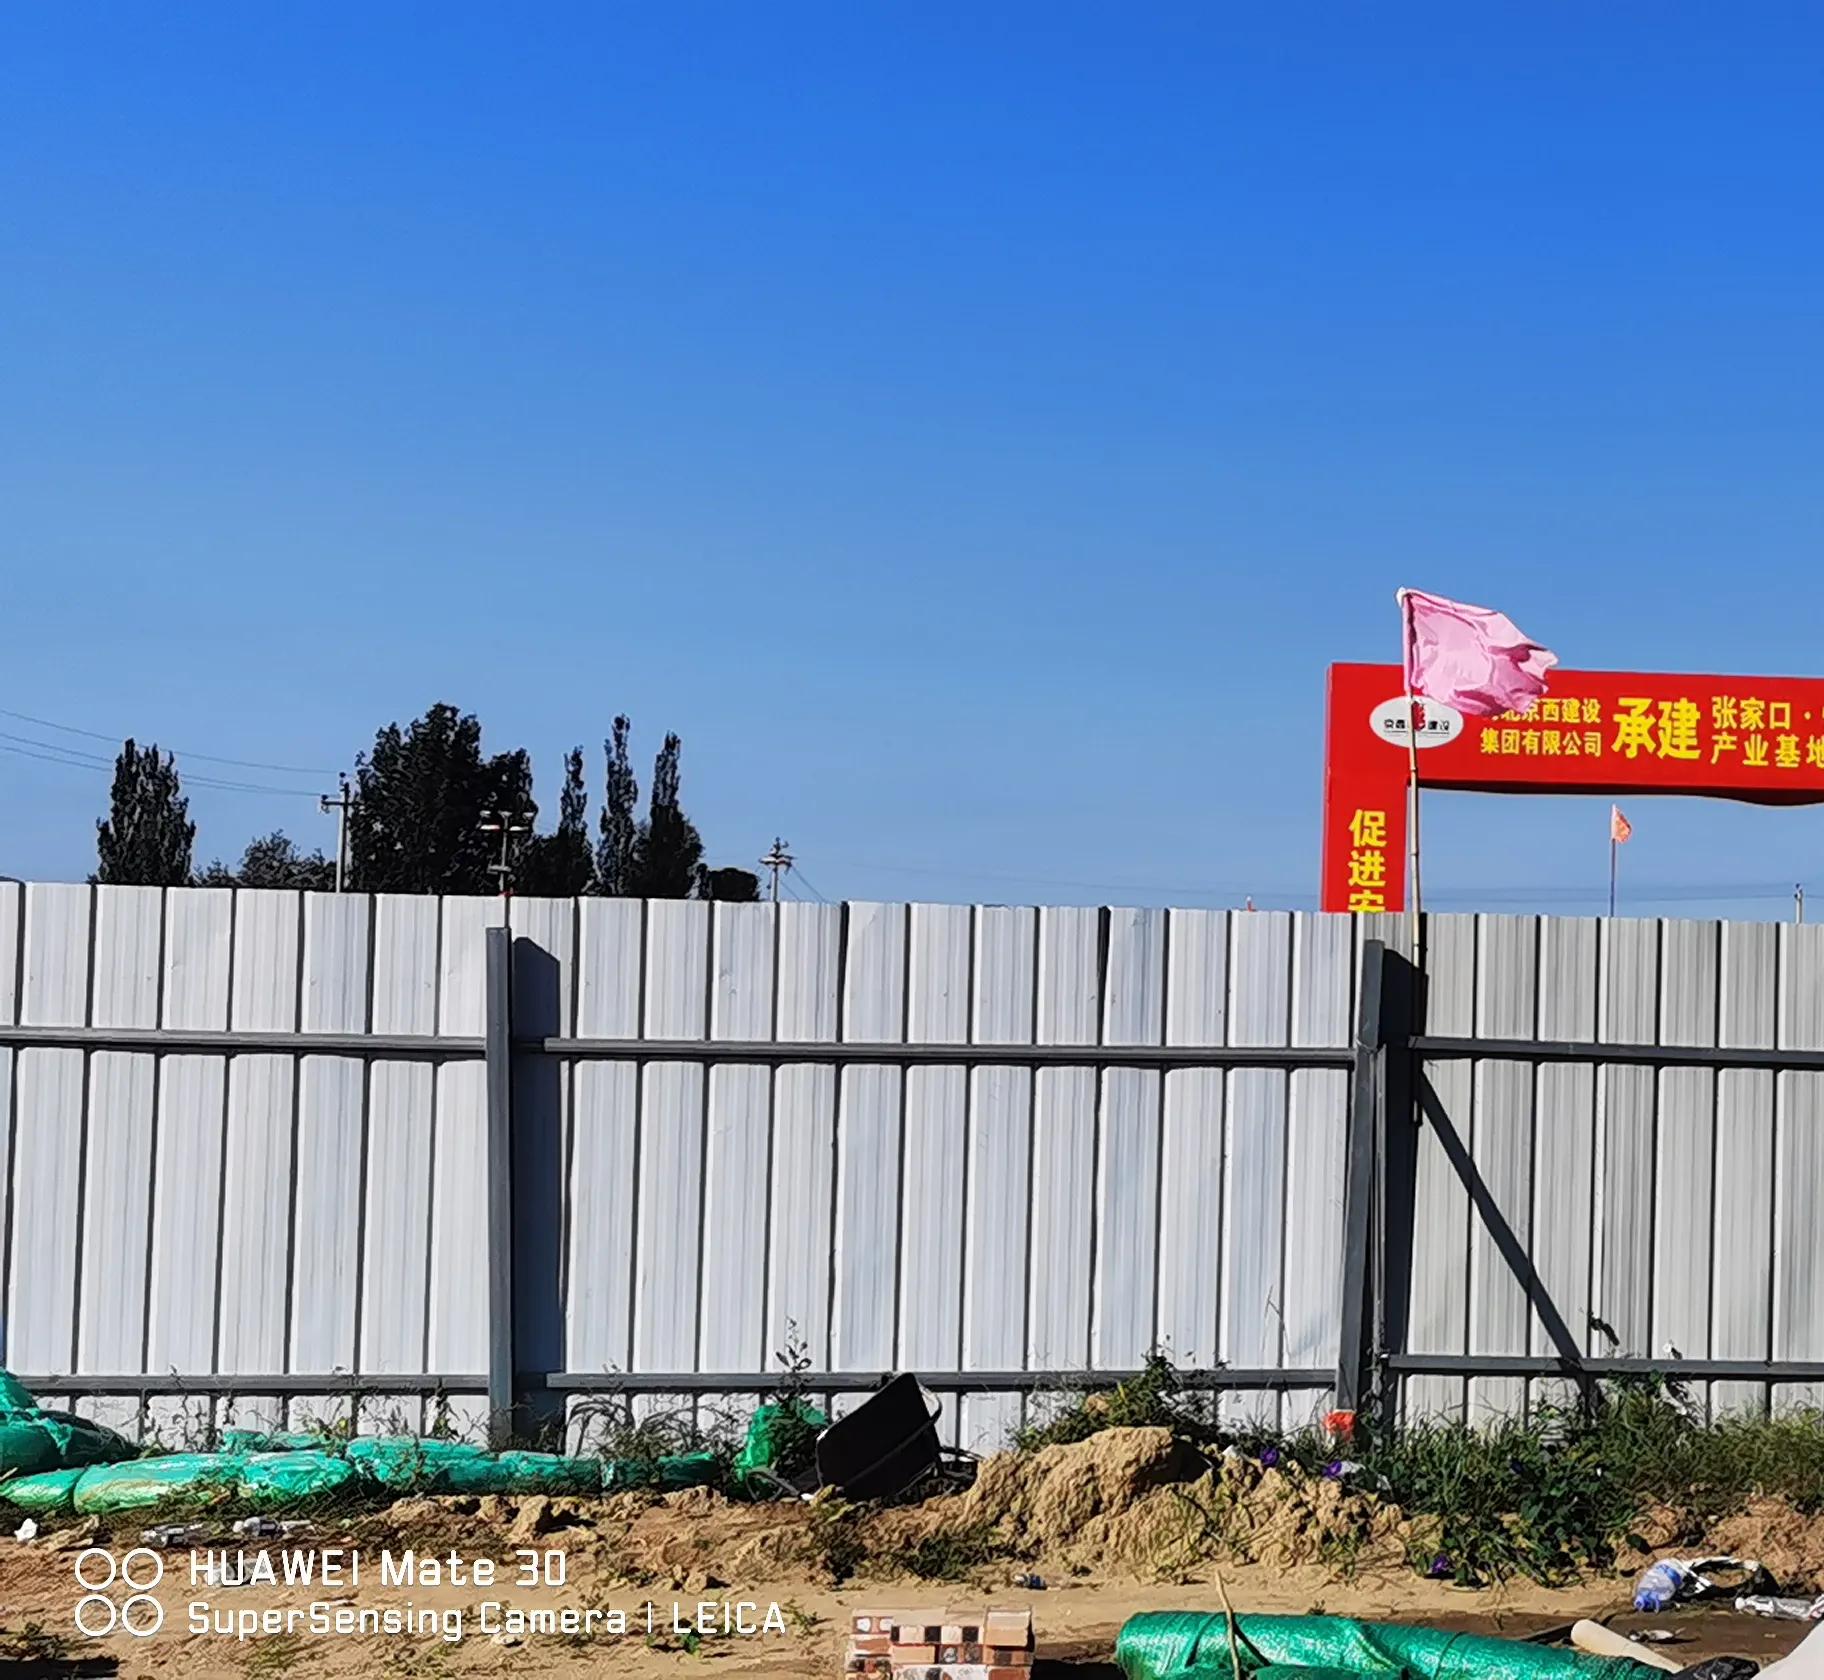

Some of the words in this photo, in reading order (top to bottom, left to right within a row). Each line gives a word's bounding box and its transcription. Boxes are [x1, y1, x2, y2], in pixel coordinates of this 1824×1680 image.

[1492, 697, 1601, 723] 京西建设
[1480, 727, 1602, 757] 集团有限公司
[1611, 697, 1702, 759] 承建
